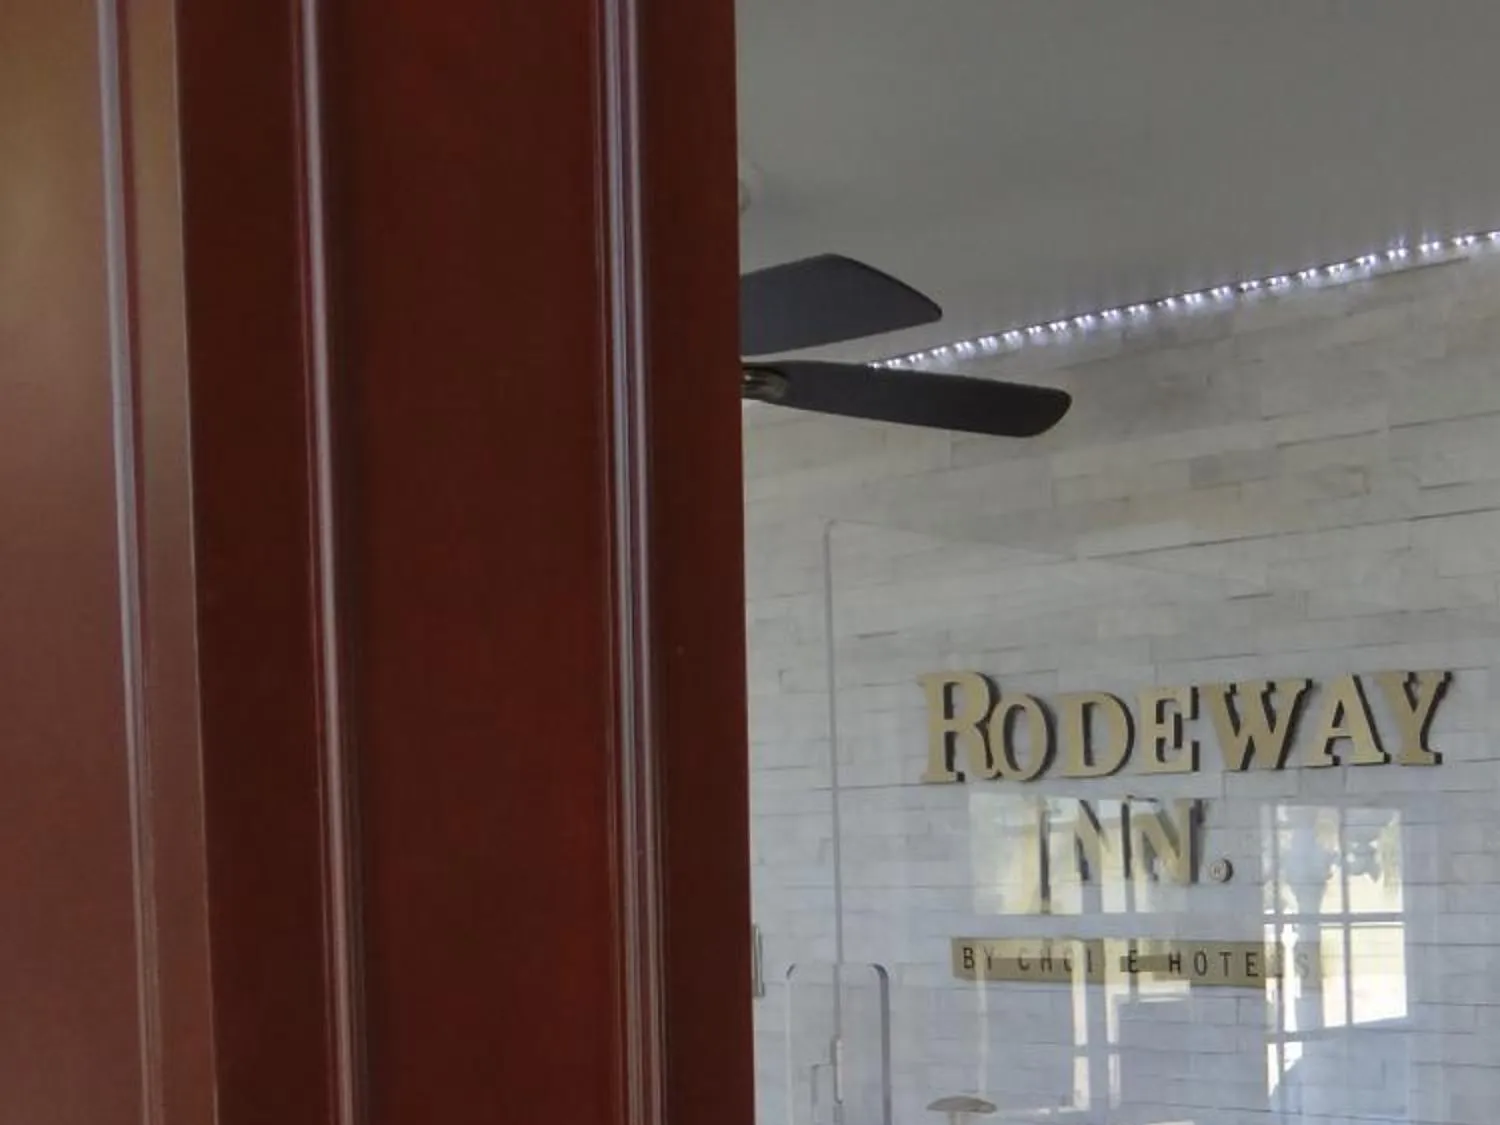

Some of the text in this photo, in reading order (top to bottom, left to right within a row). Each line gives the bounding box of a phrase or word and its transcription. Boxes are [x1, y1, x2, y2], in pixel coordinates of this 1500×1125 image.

[917, 670, 1452, 783] RODEWAY
[1016, 793, 1208, 912] INN
[963, 946, 995, 971] BY
